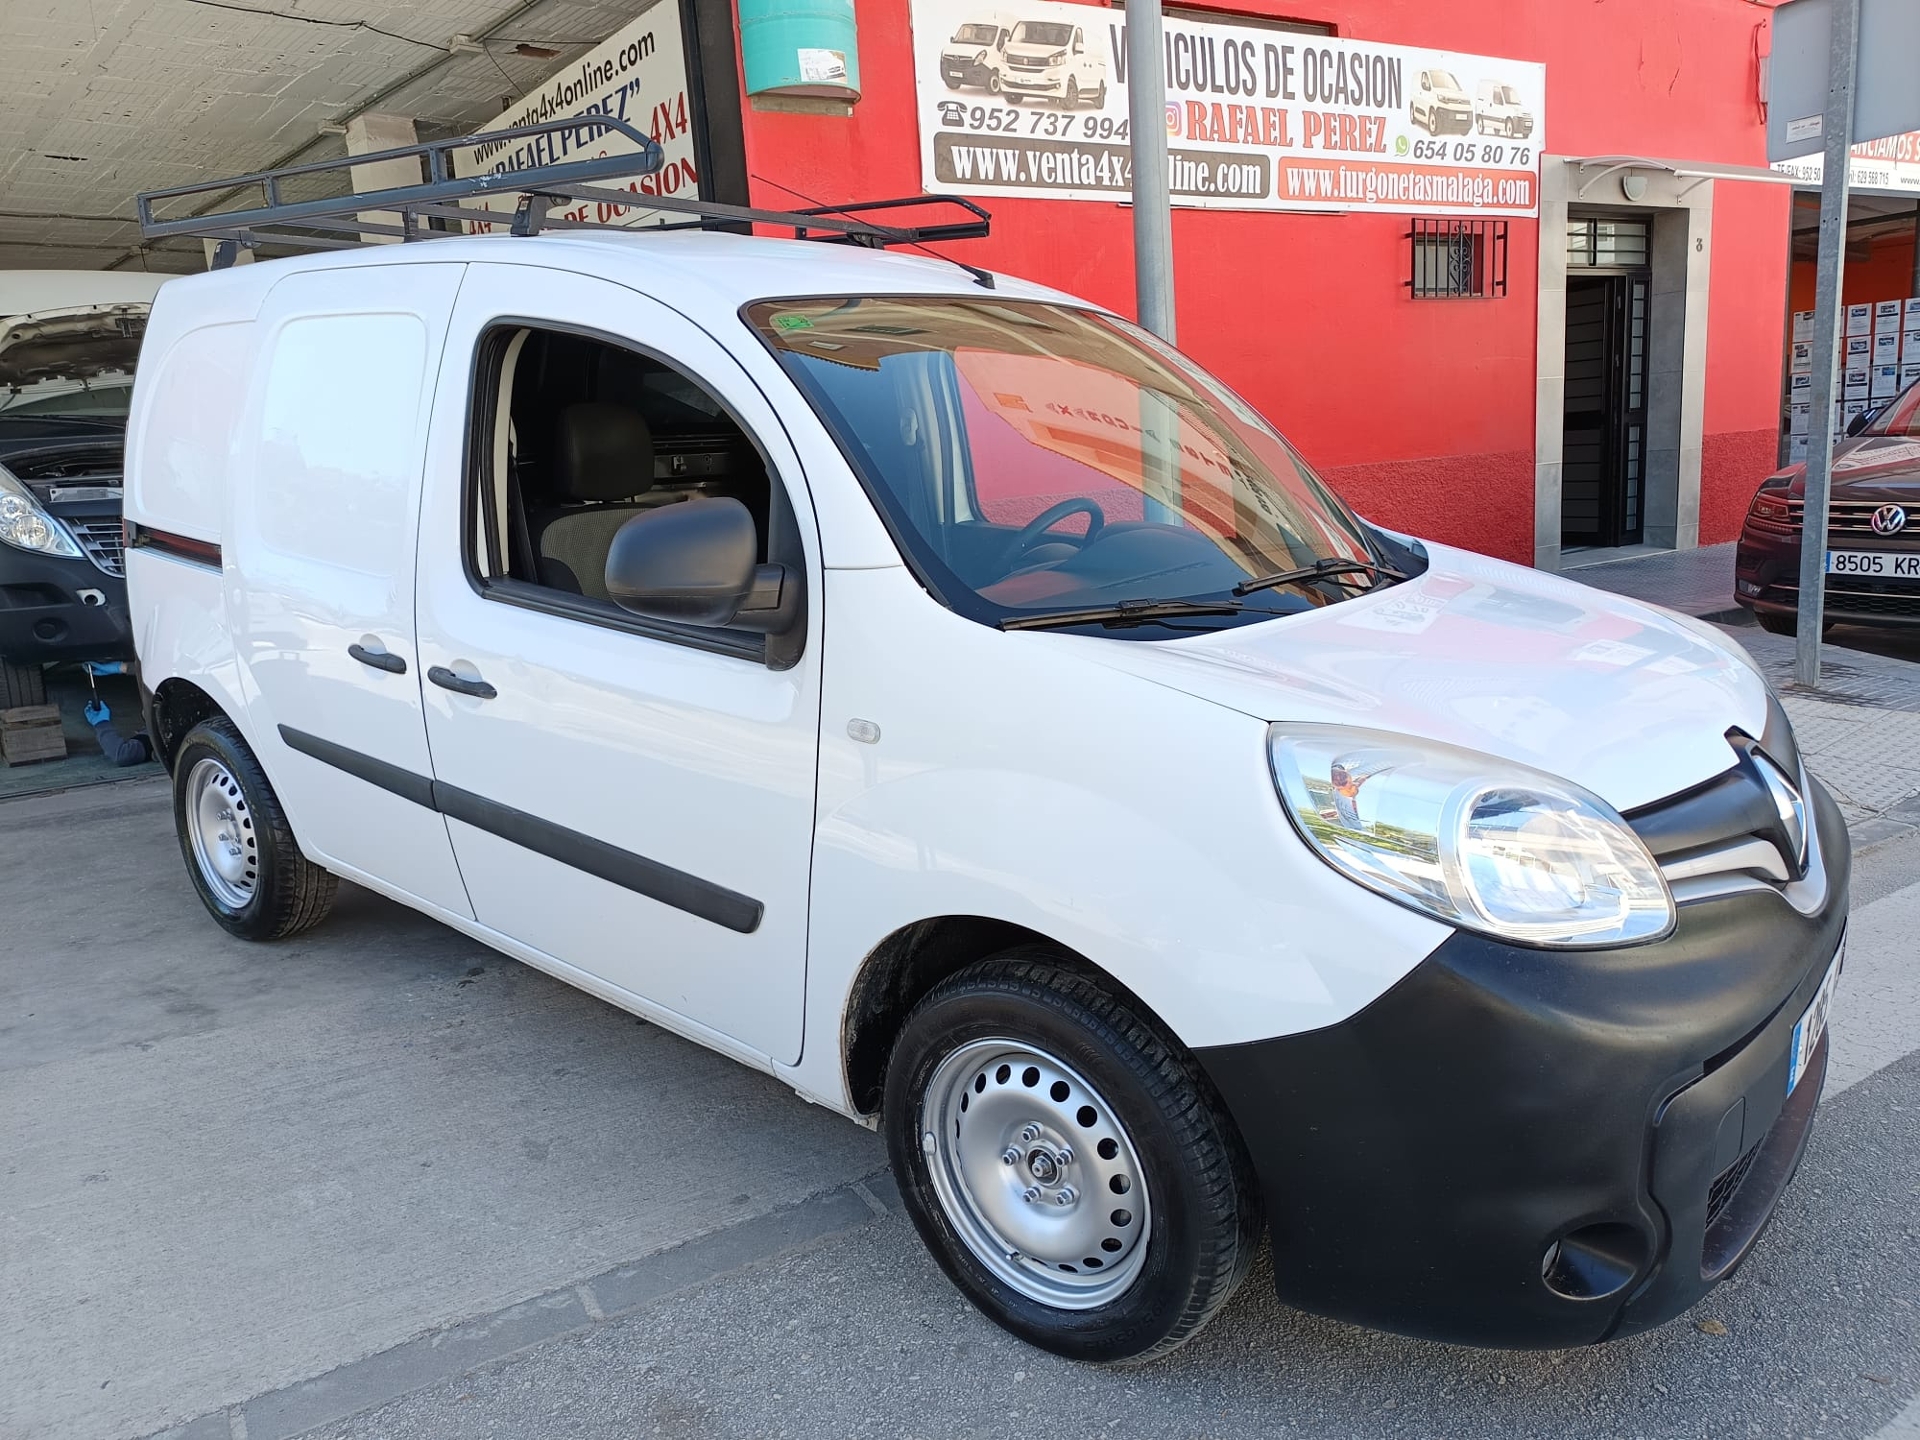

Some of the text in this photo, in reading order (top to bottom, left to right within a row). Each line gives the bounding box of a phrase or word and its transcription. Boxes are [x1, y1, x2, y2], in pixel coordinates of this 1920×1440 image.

[1109, 23, 1402, 109] VICULOS DE OCASION
[650, 91, 689, 146] 4X4
[969, 107, 1129, 141] 952 737 994
[1186, 100, 1387, 154] RAFAEL PEREZ
[951, 146, 1261, 194] www.venta4xline.com
[1413, 140, 1531, 166] 654 05 80 76
[1286, 166, 1530, 207] www.furgonetasmalaga.com
[1900, 177, 1920, 185] www.
[1835, 554, 1920, 576] 8505 KR
